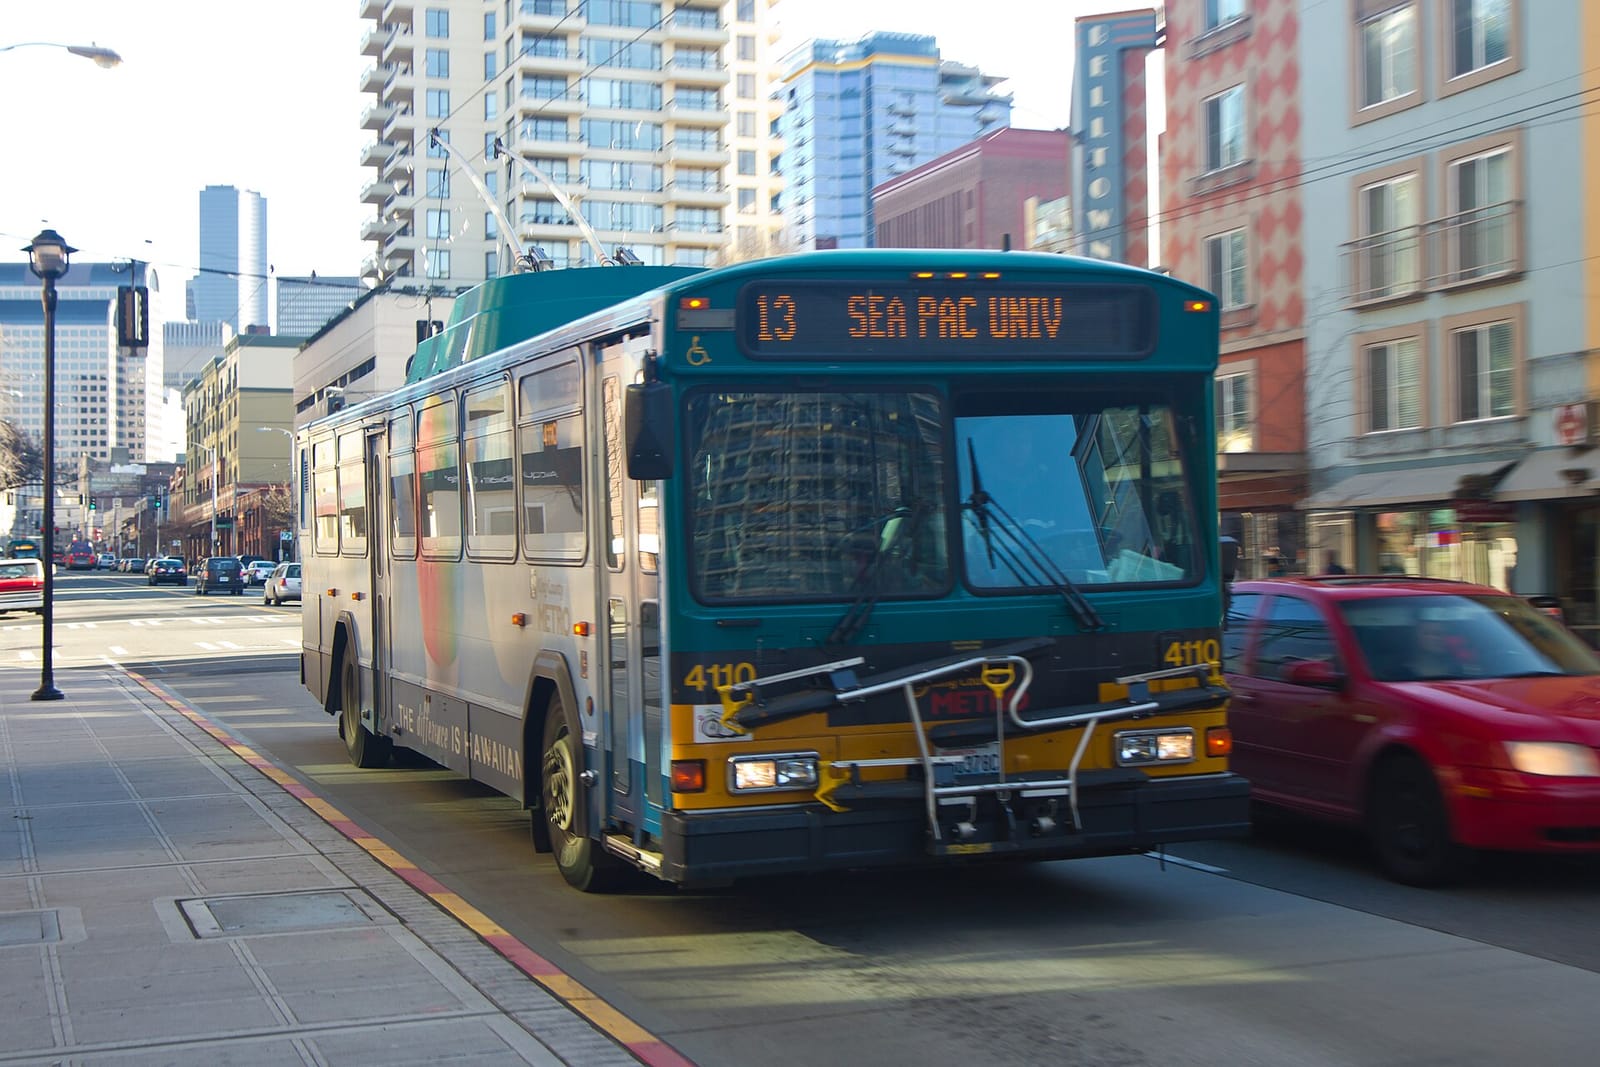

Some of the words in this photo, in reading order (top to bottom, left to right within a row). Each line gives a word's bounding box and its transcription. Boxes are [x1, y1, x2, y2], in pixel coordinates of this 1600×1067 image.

[757, 295, 797, 341] 13
[847, 296, 908, 338] SEA
[917, 296, 978, 338] PAC
[988, 297, 1063, 338] UNIV
[1164, 638, 1220, 667] 4110
[683, 662, 758, 692] 4110
[398, 703, 414, 734] THE
[416, 696, 449, 749] difference
[451, 725, 460, 755] IS
[464, 730, 523, 780] HAWAIIAN
